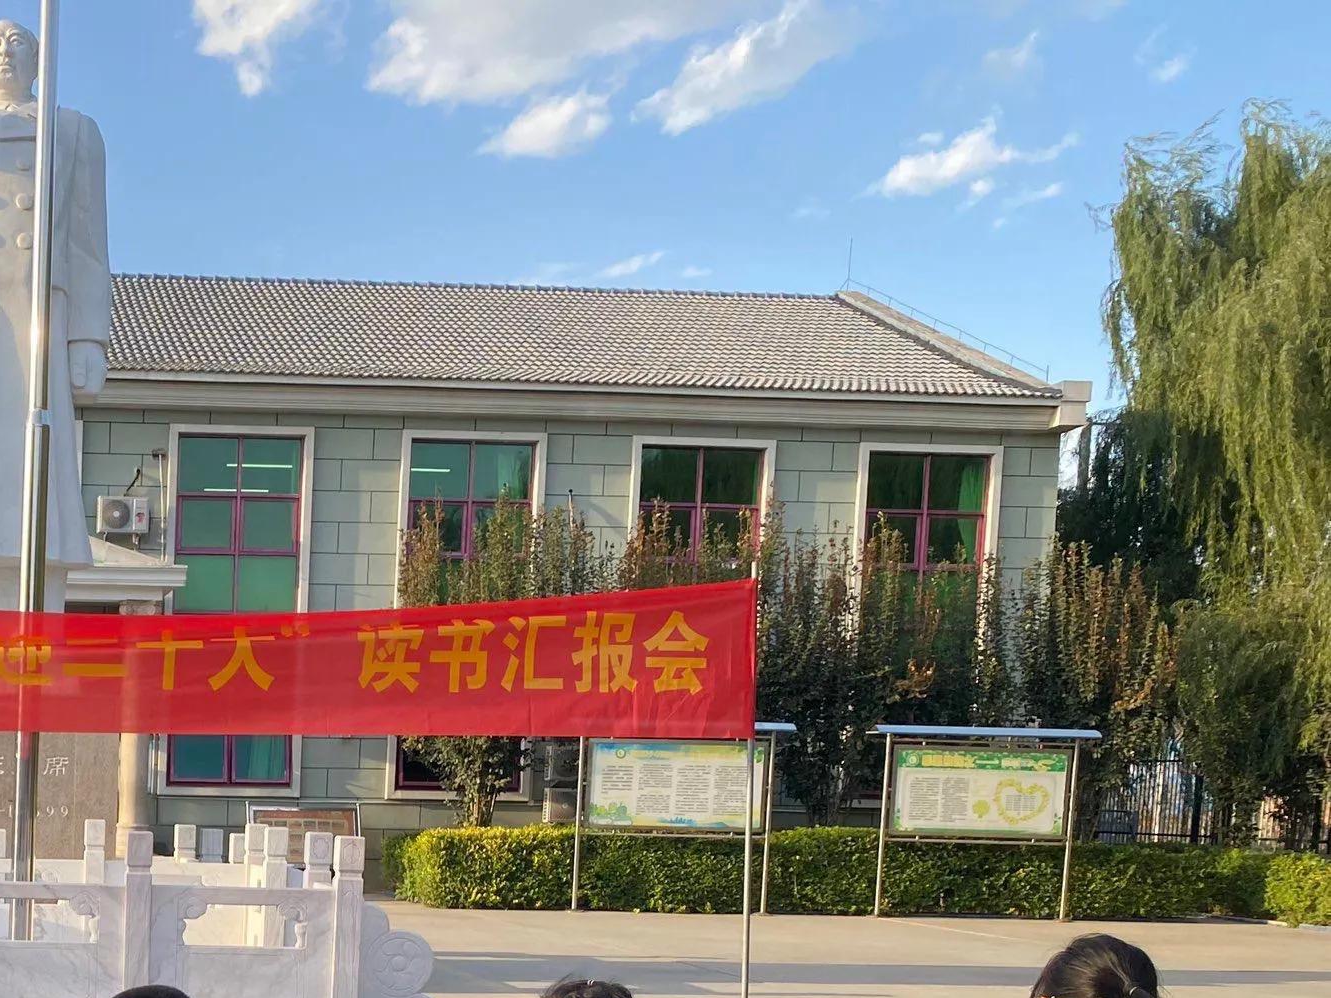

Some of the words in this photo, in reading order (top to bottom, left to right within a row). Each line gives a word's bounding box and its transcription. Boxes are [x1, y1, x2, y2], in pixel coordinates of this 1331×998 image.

[357, 610, 710, 695] 读书汇报会
